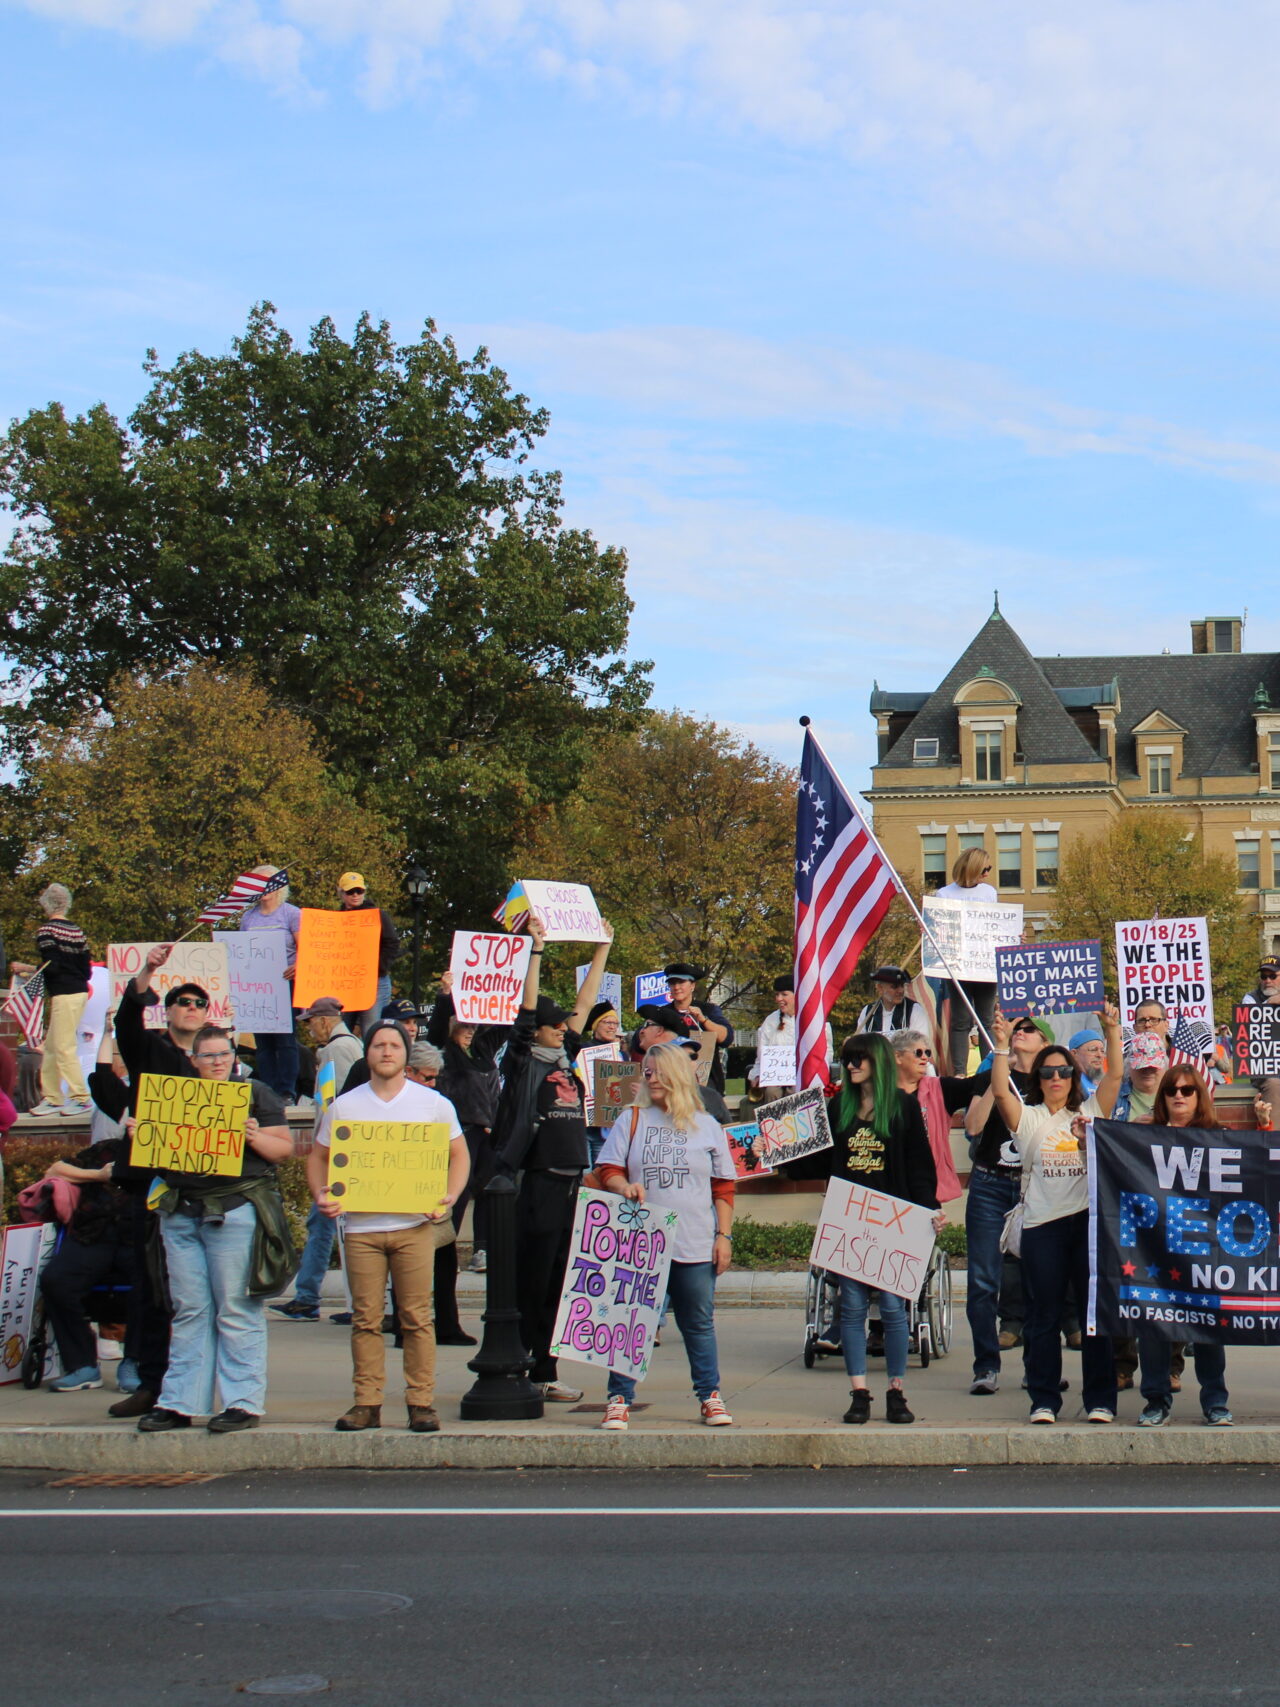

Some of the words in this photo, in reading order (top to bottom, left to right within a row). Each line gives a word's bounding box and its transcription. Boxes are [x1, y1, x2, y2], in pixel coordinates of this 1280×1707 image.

[546, 887, 582, 905] CHOOSE
[534, 905, 602, 937] DEMOCRACY
[1122, 922, 1197, 943] 10/18/25
[112, 946, 141, 973] NO
[465, 934, 525, 969] STOP
[1000, 951, 1047, 967] HATE
[1051, 948, 1096, 963] WILL
[1124, 944, 1157, 964] WE
[1163, 942, 1203, 961] THE
[308, 964, 326, 976] NO
[331, 964, 368, 976] KINGS
[1001, 968, 1039, 984] NOT
[1044, 964, 1098, 981] MAKE
[1125, 963, 1205, 985] PEOPLE
[307, 979, 325, 990] NO
[640, 976, 657, 990] NO
[1002, 986, 1027, 1001] US
[1034, 980, 1098, 998] GREAT
[1126, 984, 1205, 1006] DEFEND
[1236, 1024, 1271, 1040] ARE
[600, 1063, 613, 1078] NO
[145, 1075, 177, 1101] NO
[181, 1079, 249, 1108] ONE'S
[141, 1099, 241, 1132] ILLEGAL
[352, 1124, 395, 1141] FUCK
[400, 1123, 432, 1142] ICE
[645, 1126, 688, 1145] PBS
[761, 1102, 818, 1155] RESIST
[137, 1122, 168, 1148] ON
[169, 1125, 243, 1158] STOLEN
[350, 1150, 376, 1169] FREE
[642, 1144, 688, 1165] NPR
[643, 1166, 689, 1190] FDT
[1151, 1144, 1242, 1193] WE
[845, 1185, 913, 1235] HEX
[580, 1199, 667, 1271] Power
[862, 1227, 878, 1244] the
[815, 1223, 922, 1293] FASCISTS
[611, 1266, 661, 1309] THE
[1191, 1264, 1235, 1291] NO
[1119, 1306, 1140, 1320] NO
[1145, 1307, 1216, 1326] FASCISTS
[1233, 1316, 1255, 1329] NO
[560, 1296, 647, 1367] People
